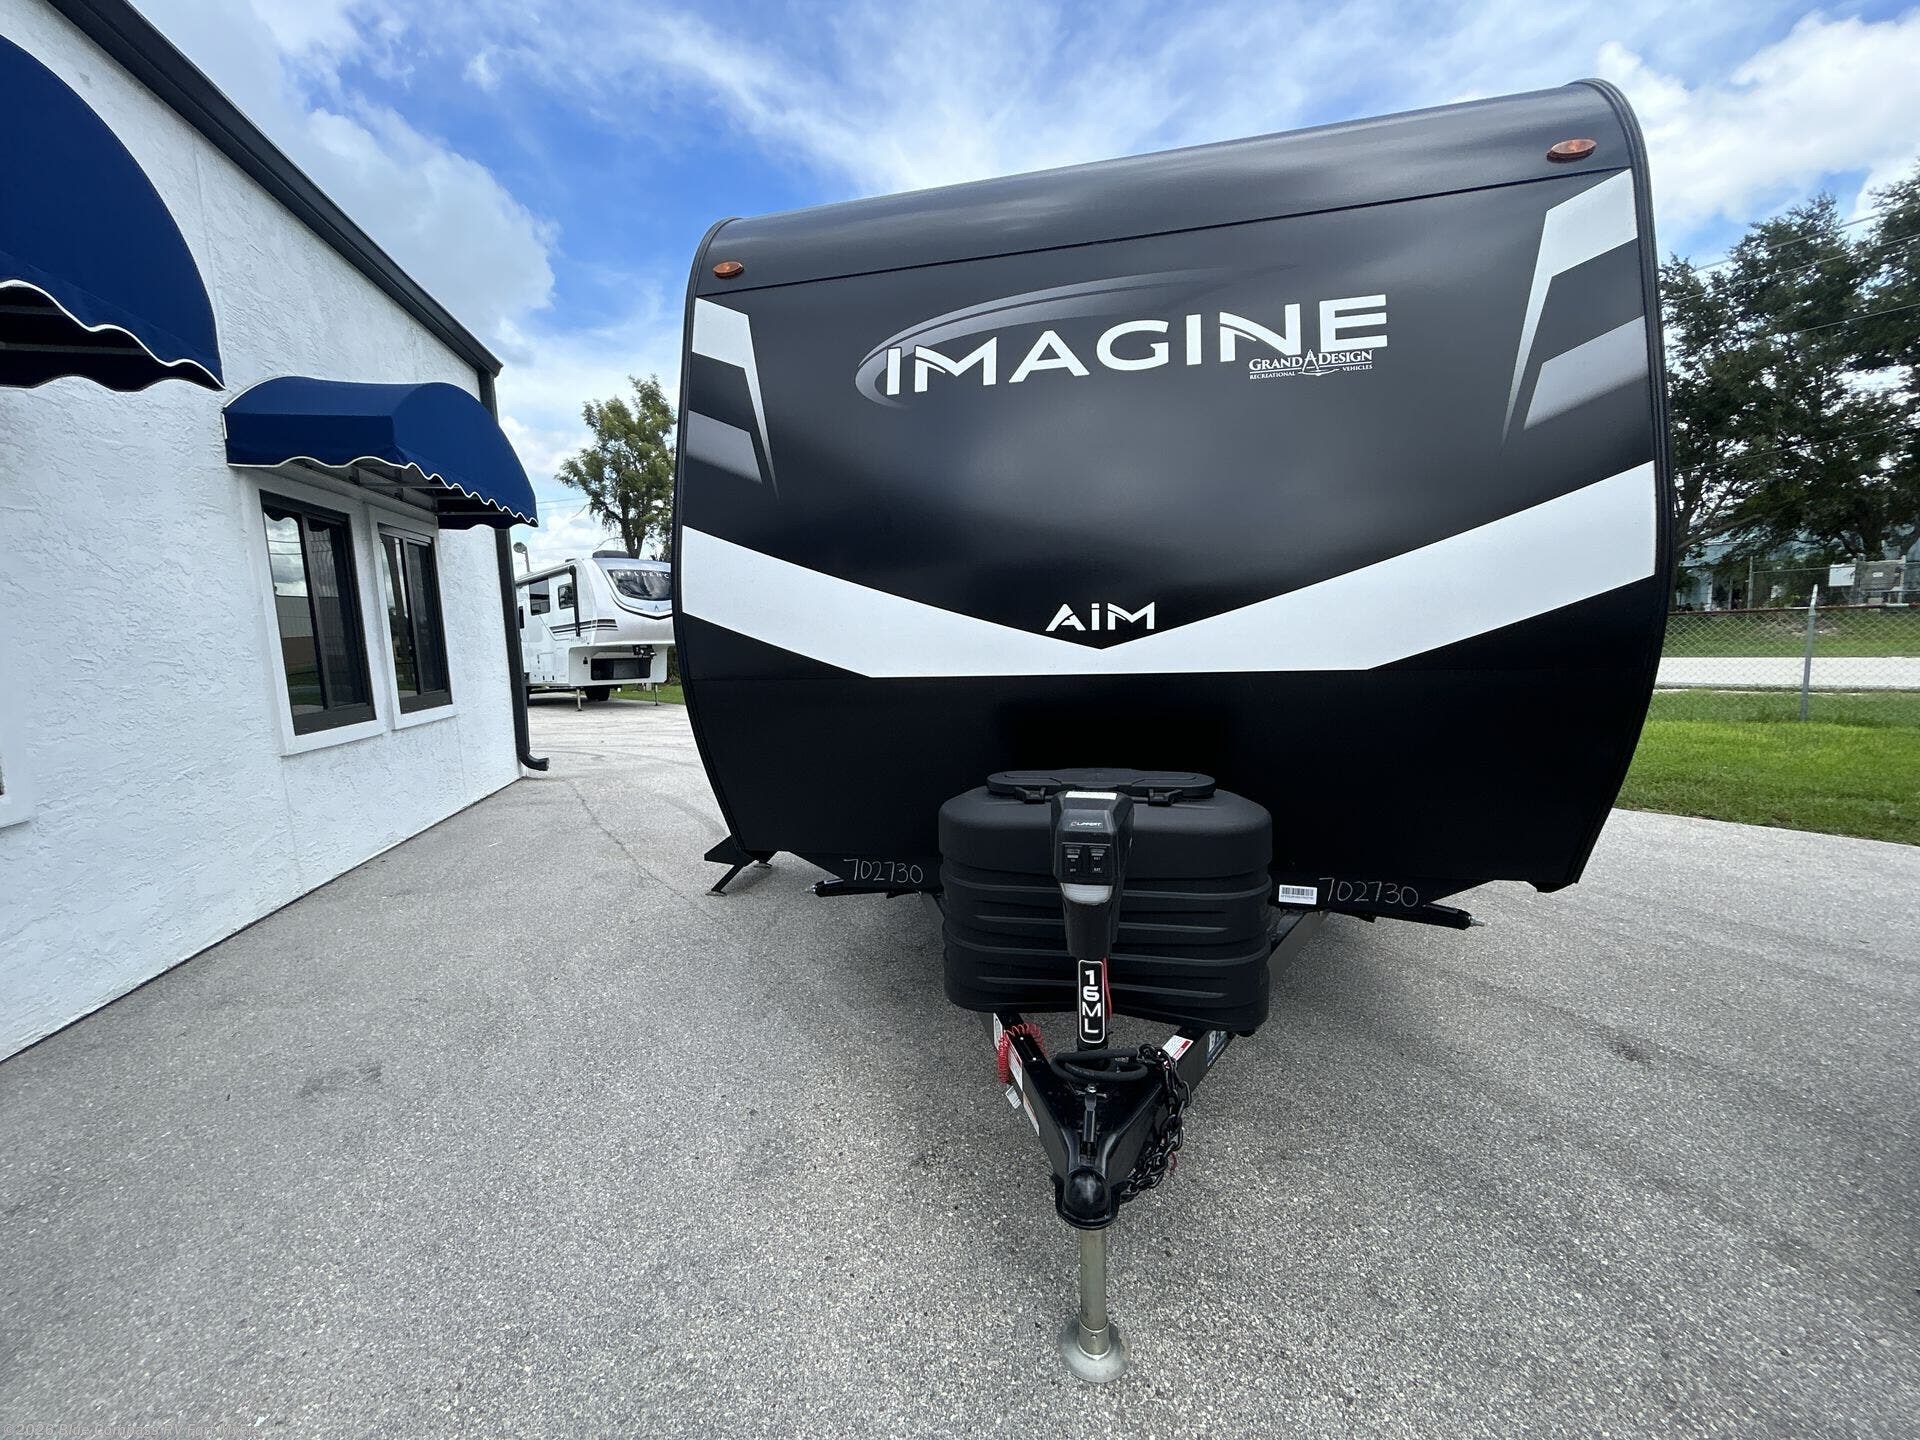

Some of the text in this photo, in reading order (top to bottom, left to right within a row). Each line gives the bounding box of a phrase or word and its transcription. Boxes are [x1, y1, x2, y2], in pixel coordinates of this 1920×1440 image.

[886, 294, 1388, 396] IMAGINE
[1249, 349, 1374, 371] GRAND DESIGN
[1250, 364, 1373, 380] RECREATIONAL VEHICLES
[612, 571, 670, 579] INFLUENC
[843, 858, 924, 884] 702730
[1319, 877, 1419, 907] 702730
